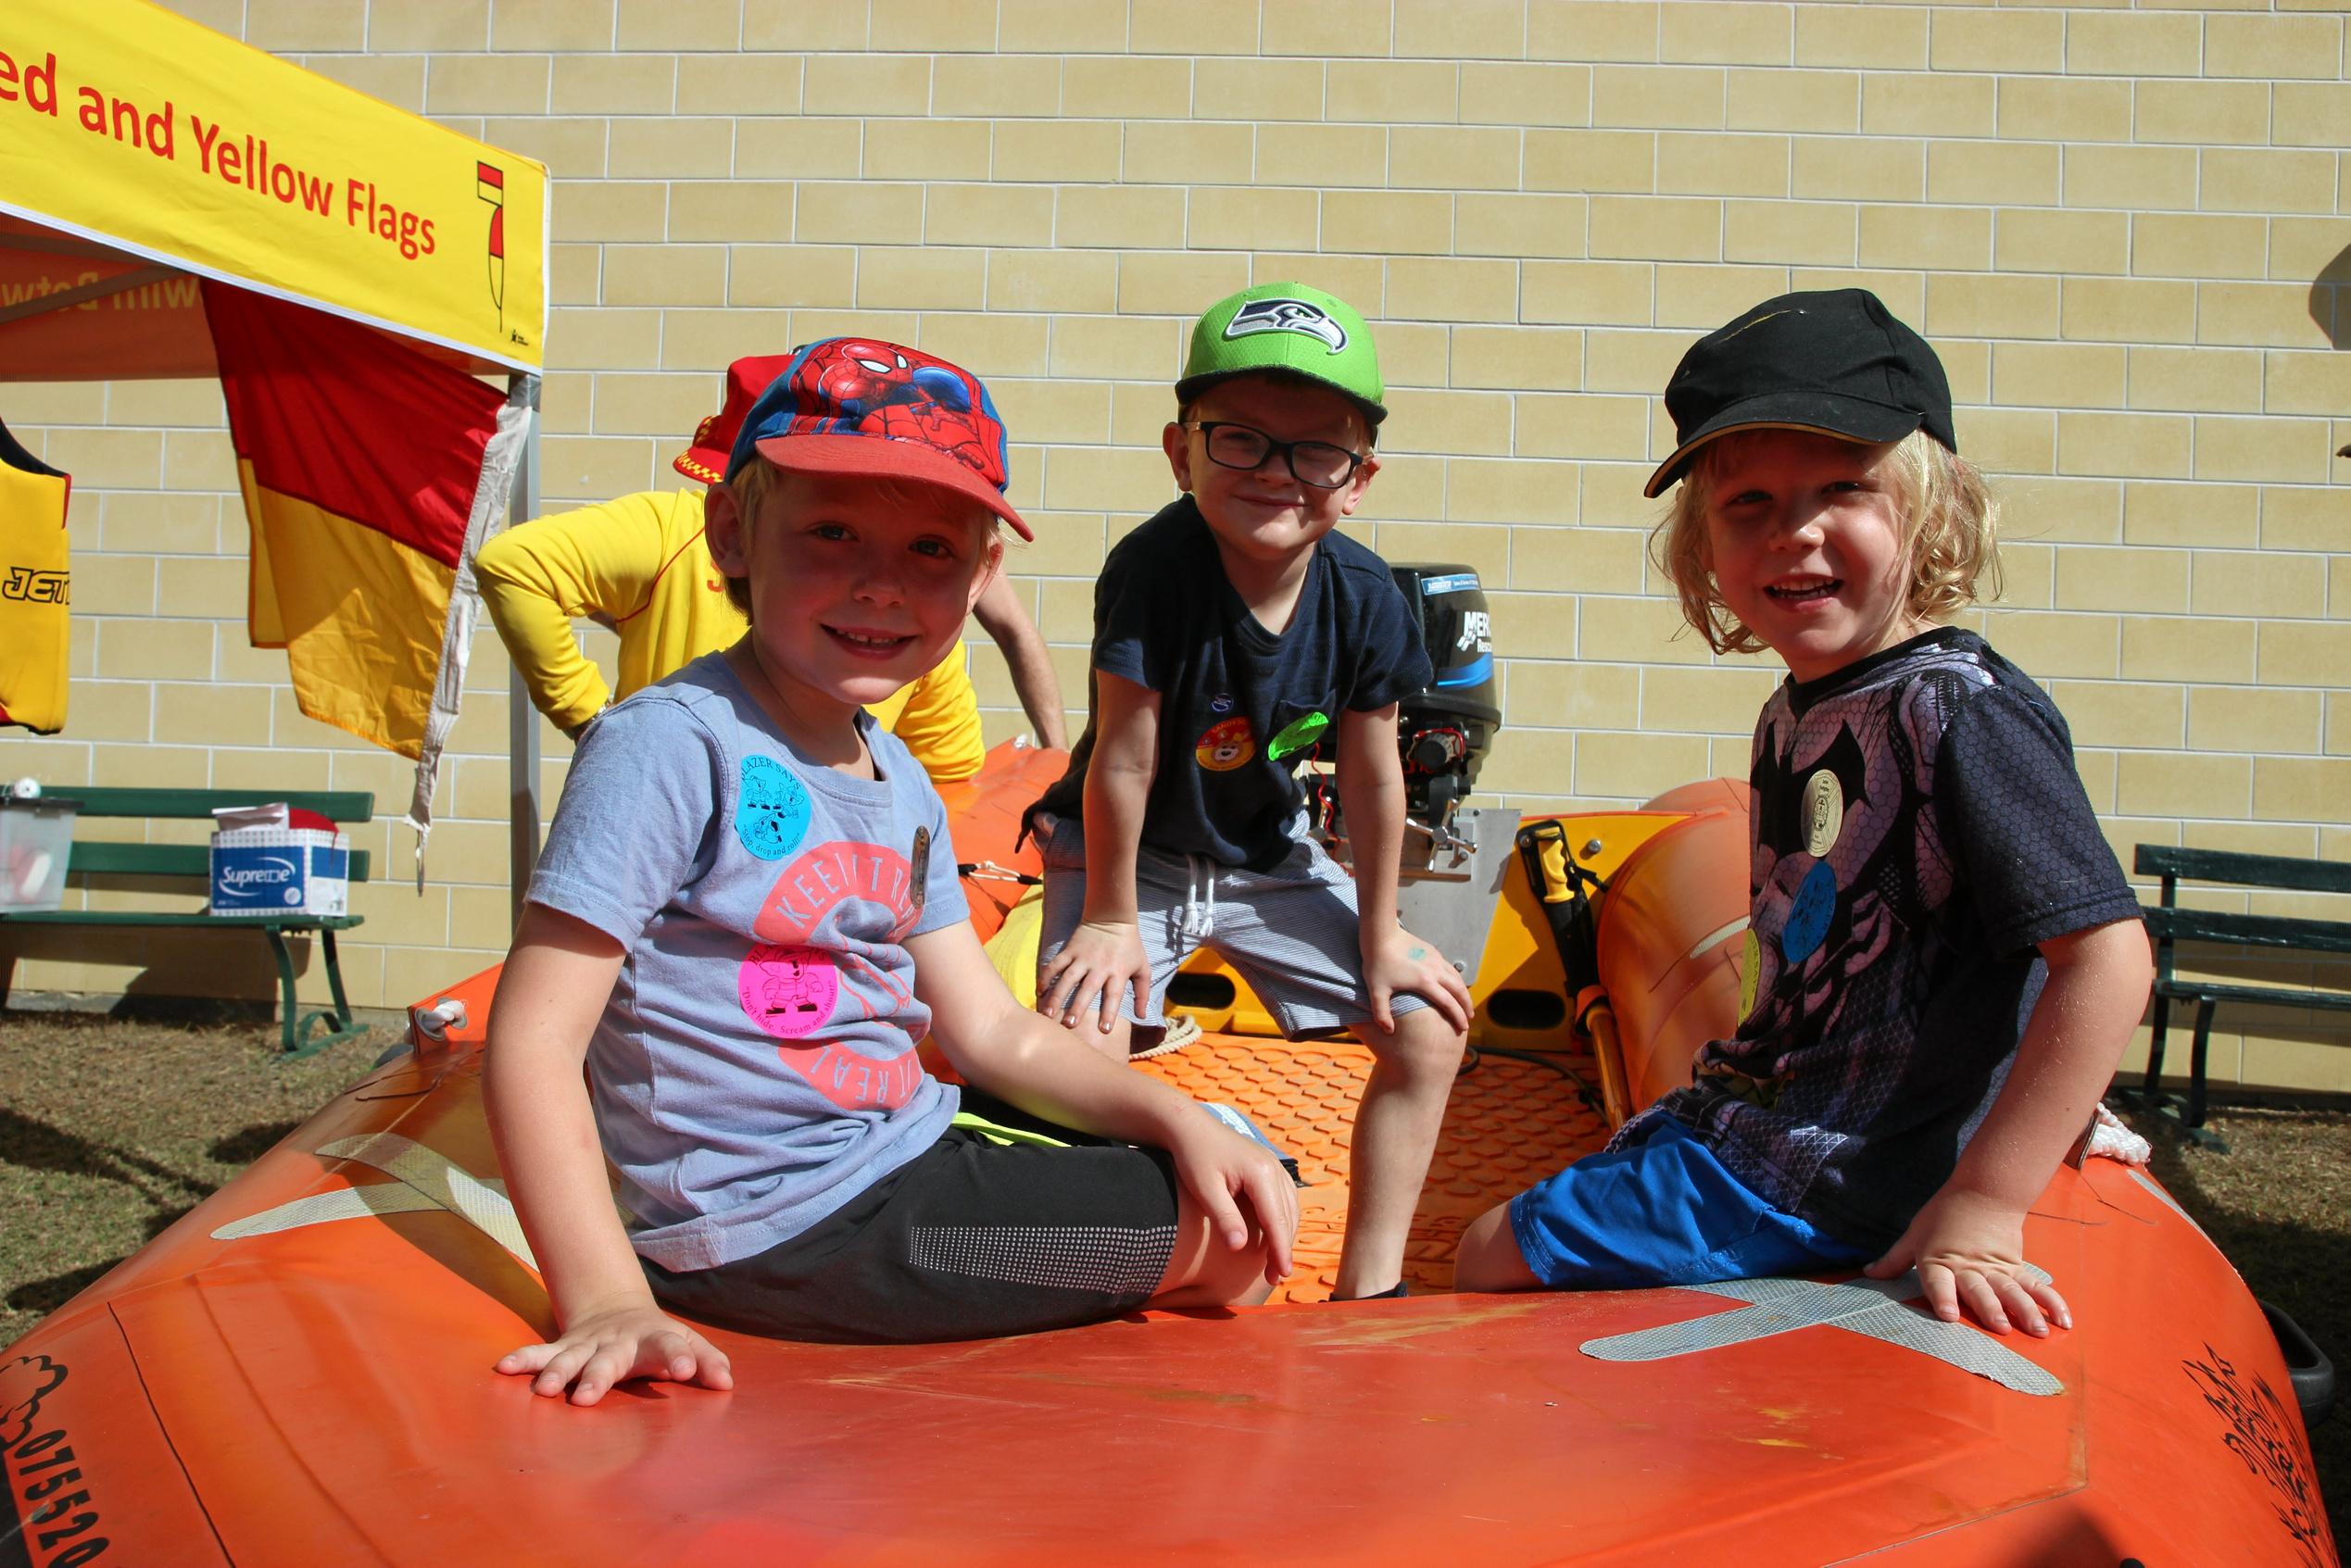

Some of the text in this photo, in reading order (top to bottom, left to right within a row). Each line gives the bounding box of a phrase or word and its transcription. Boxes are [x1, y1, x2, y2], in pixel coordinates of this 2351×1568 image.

[79, 86, 174, 160] and
[191, 115, 333, 217] Yellow
[347, 178, 435, 260] Flags
[2, 566, 70, 606] JET
[776, 764, 800, 789] SAYS
[756, 844, 771, 857] drop
[773, 846, 786, 855] and
[780, 1023, 811, 1035] Scream
[812, 1012, 825, 1026] and
[810, 1046, 889, 1103] REAL
[14, 1429, 110, 1568] 075520
